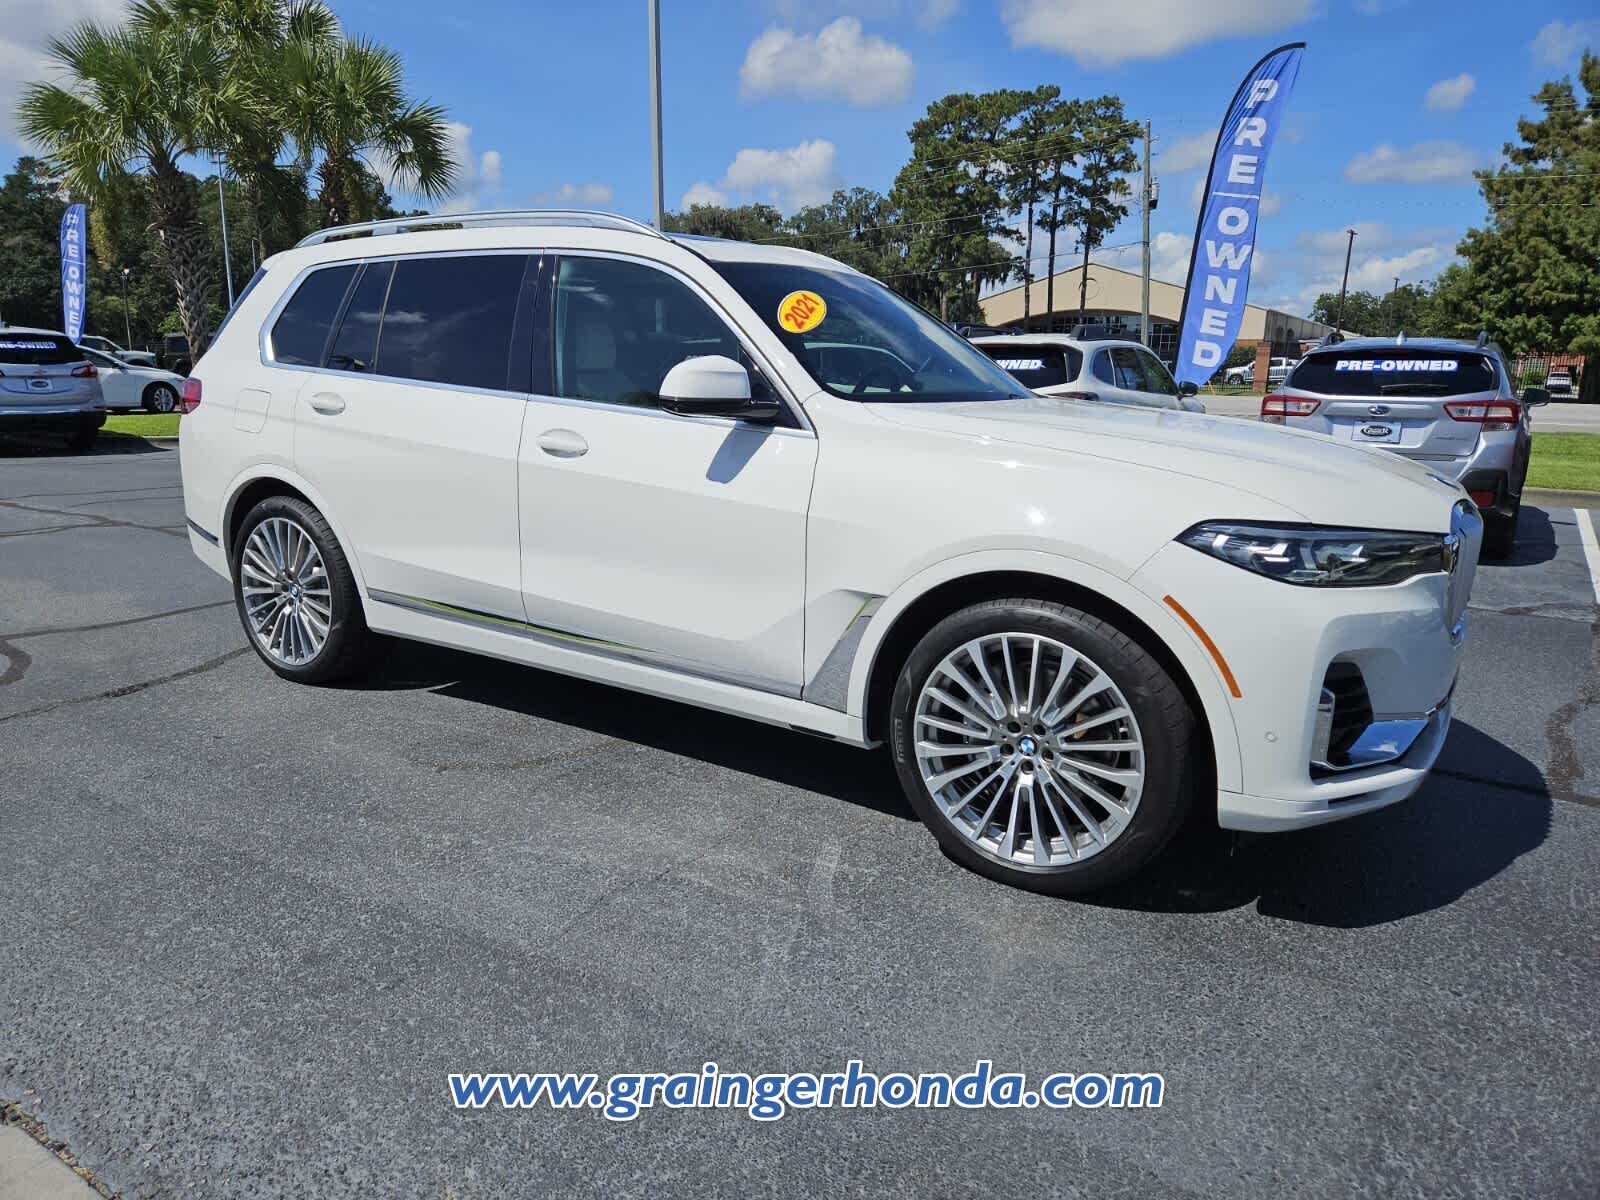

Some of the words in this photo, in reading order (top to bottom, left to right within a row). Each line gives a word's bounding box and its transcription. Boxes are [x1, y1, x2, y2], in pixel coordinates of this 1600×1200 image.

[1227, 79, 1278, 185] PRE
[785, 293, 820, 329] 2021
[1192, 206, 1252, 368] OWNED
[1335, 359, 1459, 372] PRE-OWNED
